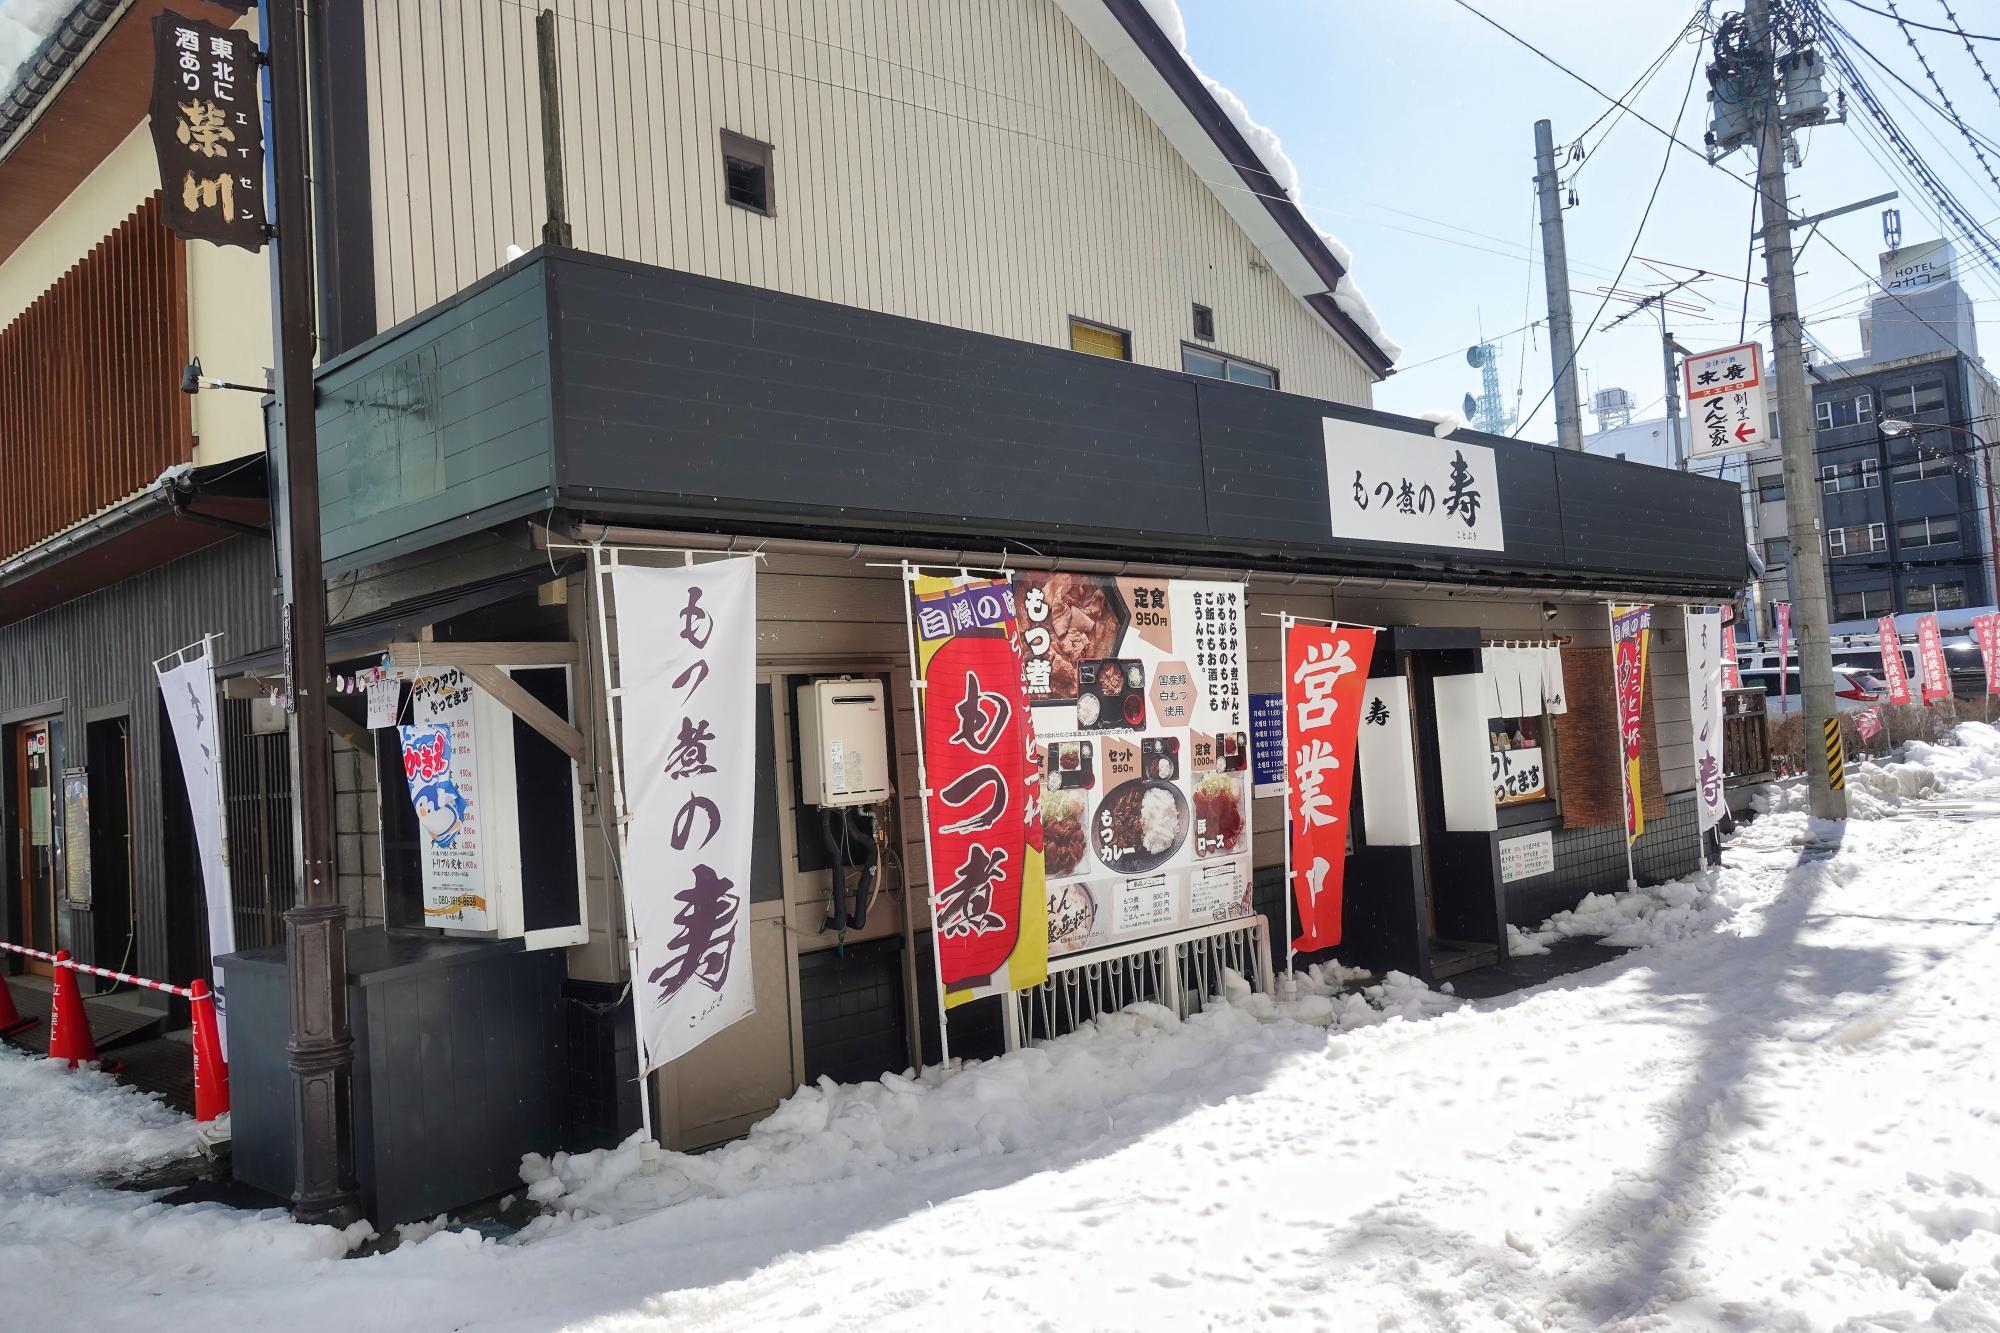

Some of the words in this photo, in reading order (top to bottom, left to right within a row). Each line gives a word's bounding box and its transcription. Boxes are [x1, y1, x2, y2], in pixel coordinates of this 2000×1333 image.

[174, 27, 200, 91] 酒あり
[209, 36, 235, 101] 東北に
[1895, 261, 1936, 278] HOTEL
[1705, 356, 1736, 369] 会津の酒
[1703, 382, 1745, 397] スエヒロ
[1703, 396, 1729, 448] てんぐ家
[1352, 449, 1482, 528] もつ煮の寿
[1456, 530, 1479, 541] ことぶき
[1133, 587, 1165, 609] 定食
[1135, 611, 1168, 627] 950円
[1614, 613, 1651, 644] 自慢の味
[1024, 587, 1052, 694] もつ煮
[1193, 592, 1206, 673] 合うんです。
[1205, 592, 1218, 711] ご飯にもお酒にも
[1227, 592, 1239, 725] やわらかく煮込んだ
[414, 668, 465, 702] テイクアウト
[1158, 675, 1187, 686] 国産豚
[430, 685, 470, 715] やってます
[1159, 691, 1187, 702] 白もつ
[1164, 706, 1185, 717] 使用
[1365, 696, 1390, 727] 寿
[403, 730, 449, 780] かき氷
[1108, 748, 1133, 762] セット
[1193, 757, 1214, 766] 1000円
[1194, 743, 1211, 756] 定食
[1112, 764, 1134, 773] 950円
[647, 586, 741, 1010] もつ煮の寿
[937, 670, 1010, 938] もつ煮
[1100, 810, 1114, 842] もつ
[1196, 818, 1207, 834] 豚
[1100, 847, 1136, 862] カレー
[1197, 834, 1225, 850] ロース
